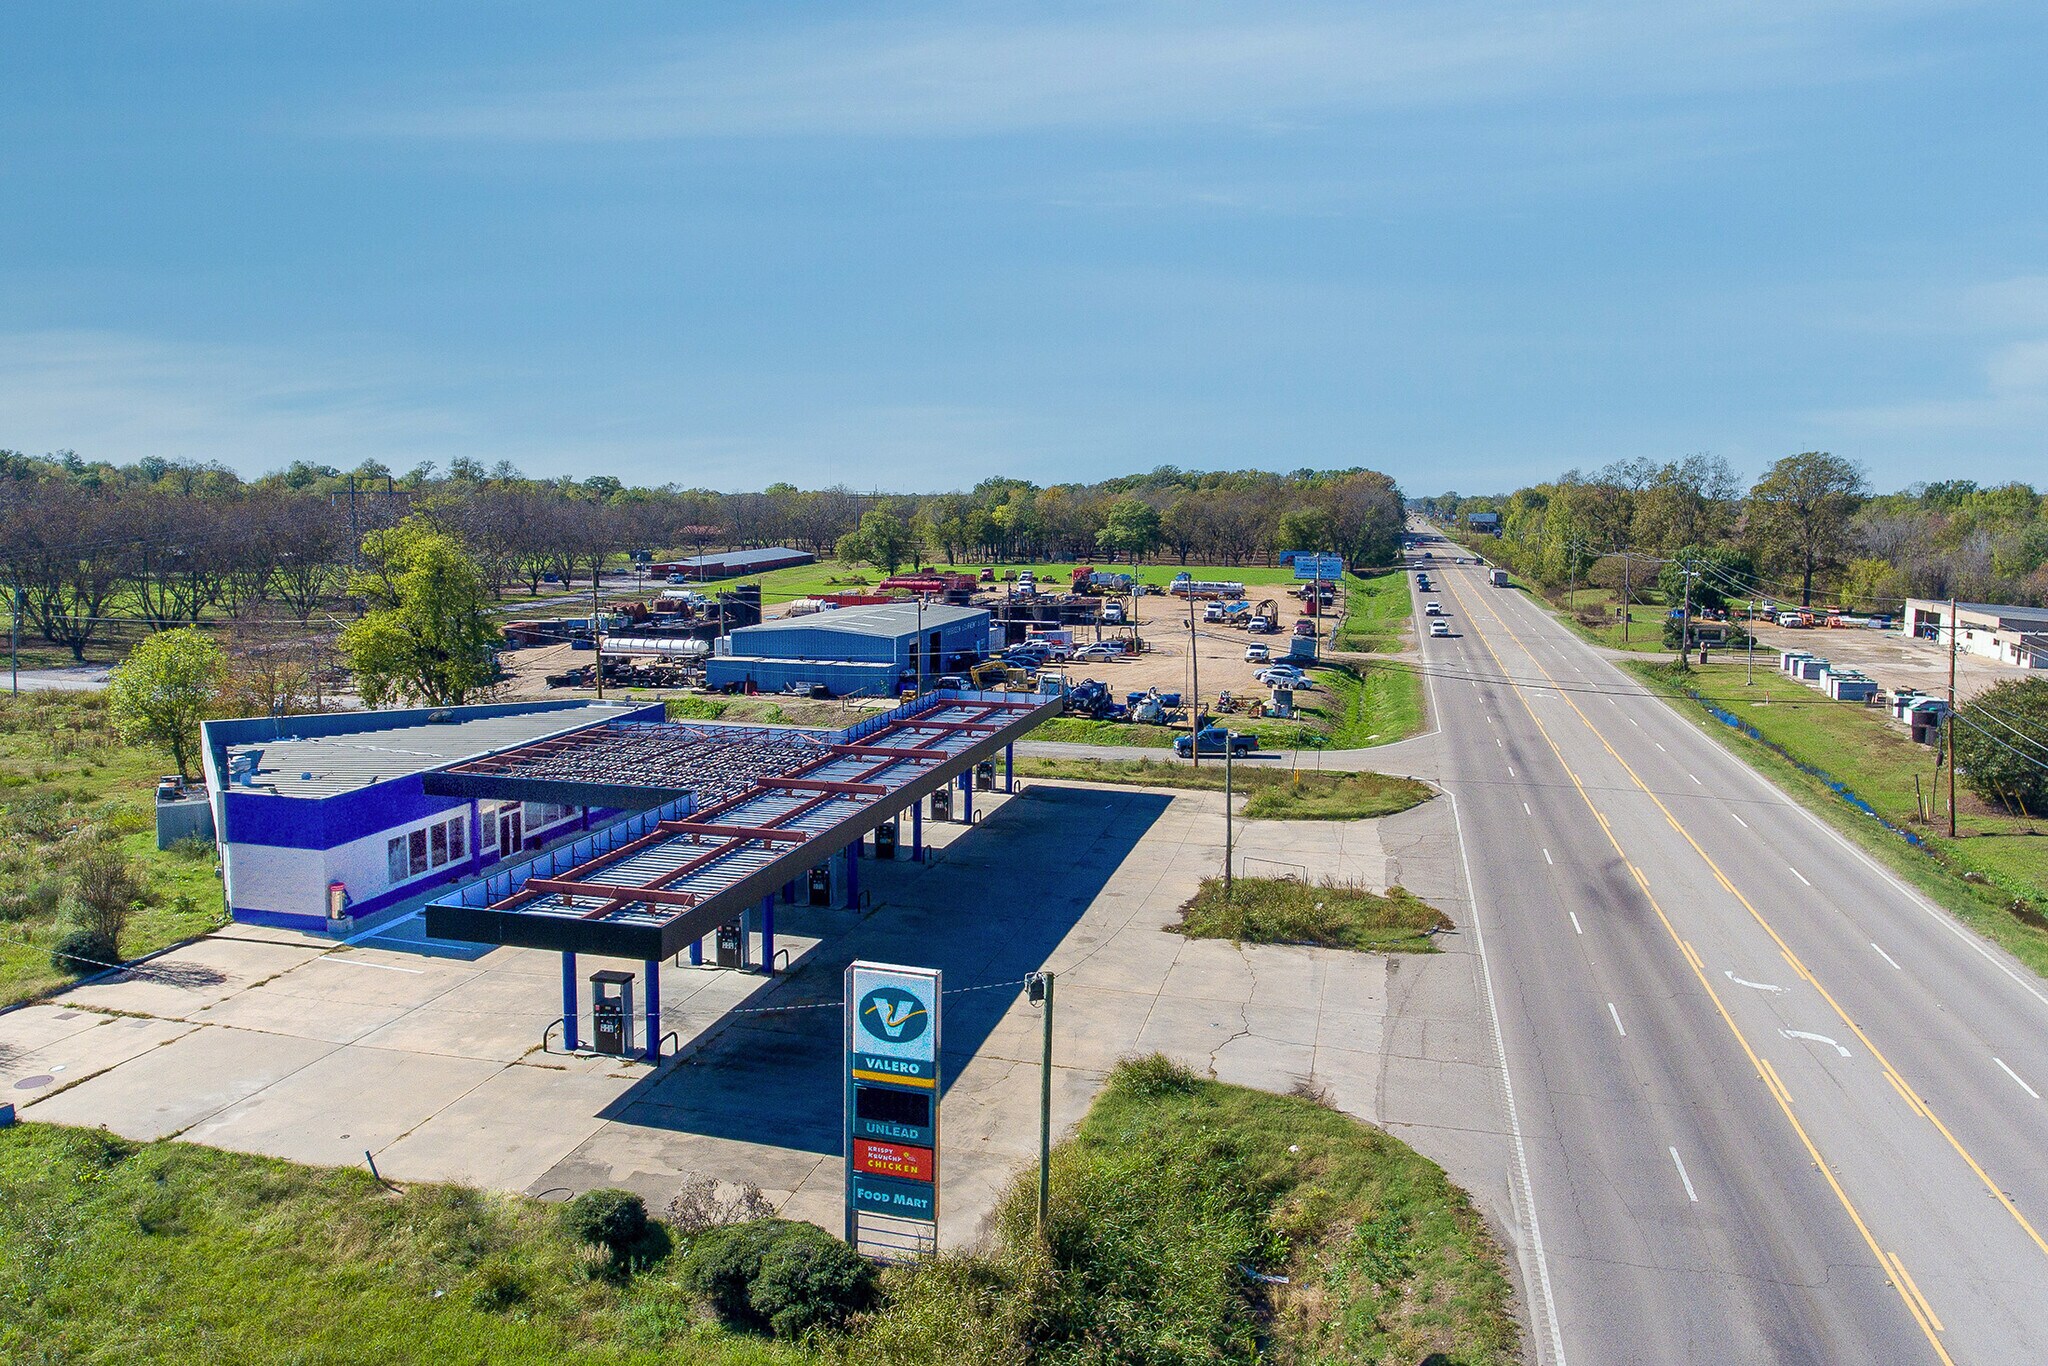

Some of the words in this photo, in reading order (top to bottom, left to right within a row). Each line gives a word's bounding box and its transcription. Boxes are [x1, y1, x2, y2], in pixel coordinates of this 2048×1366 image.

[865, 1057, 920, 1074] VALERO
[866, 1122, 919, 1139] UNLEAD
[867, 1145, 893, 1155] KRISPY
[867, 1152, 902, 1162] KRUNCHY
[867, 1159, 918, 1174] CHICKEN
[857, 1187, 890, 1203] FOOD
[893, 1193, 928, 1209] MART
